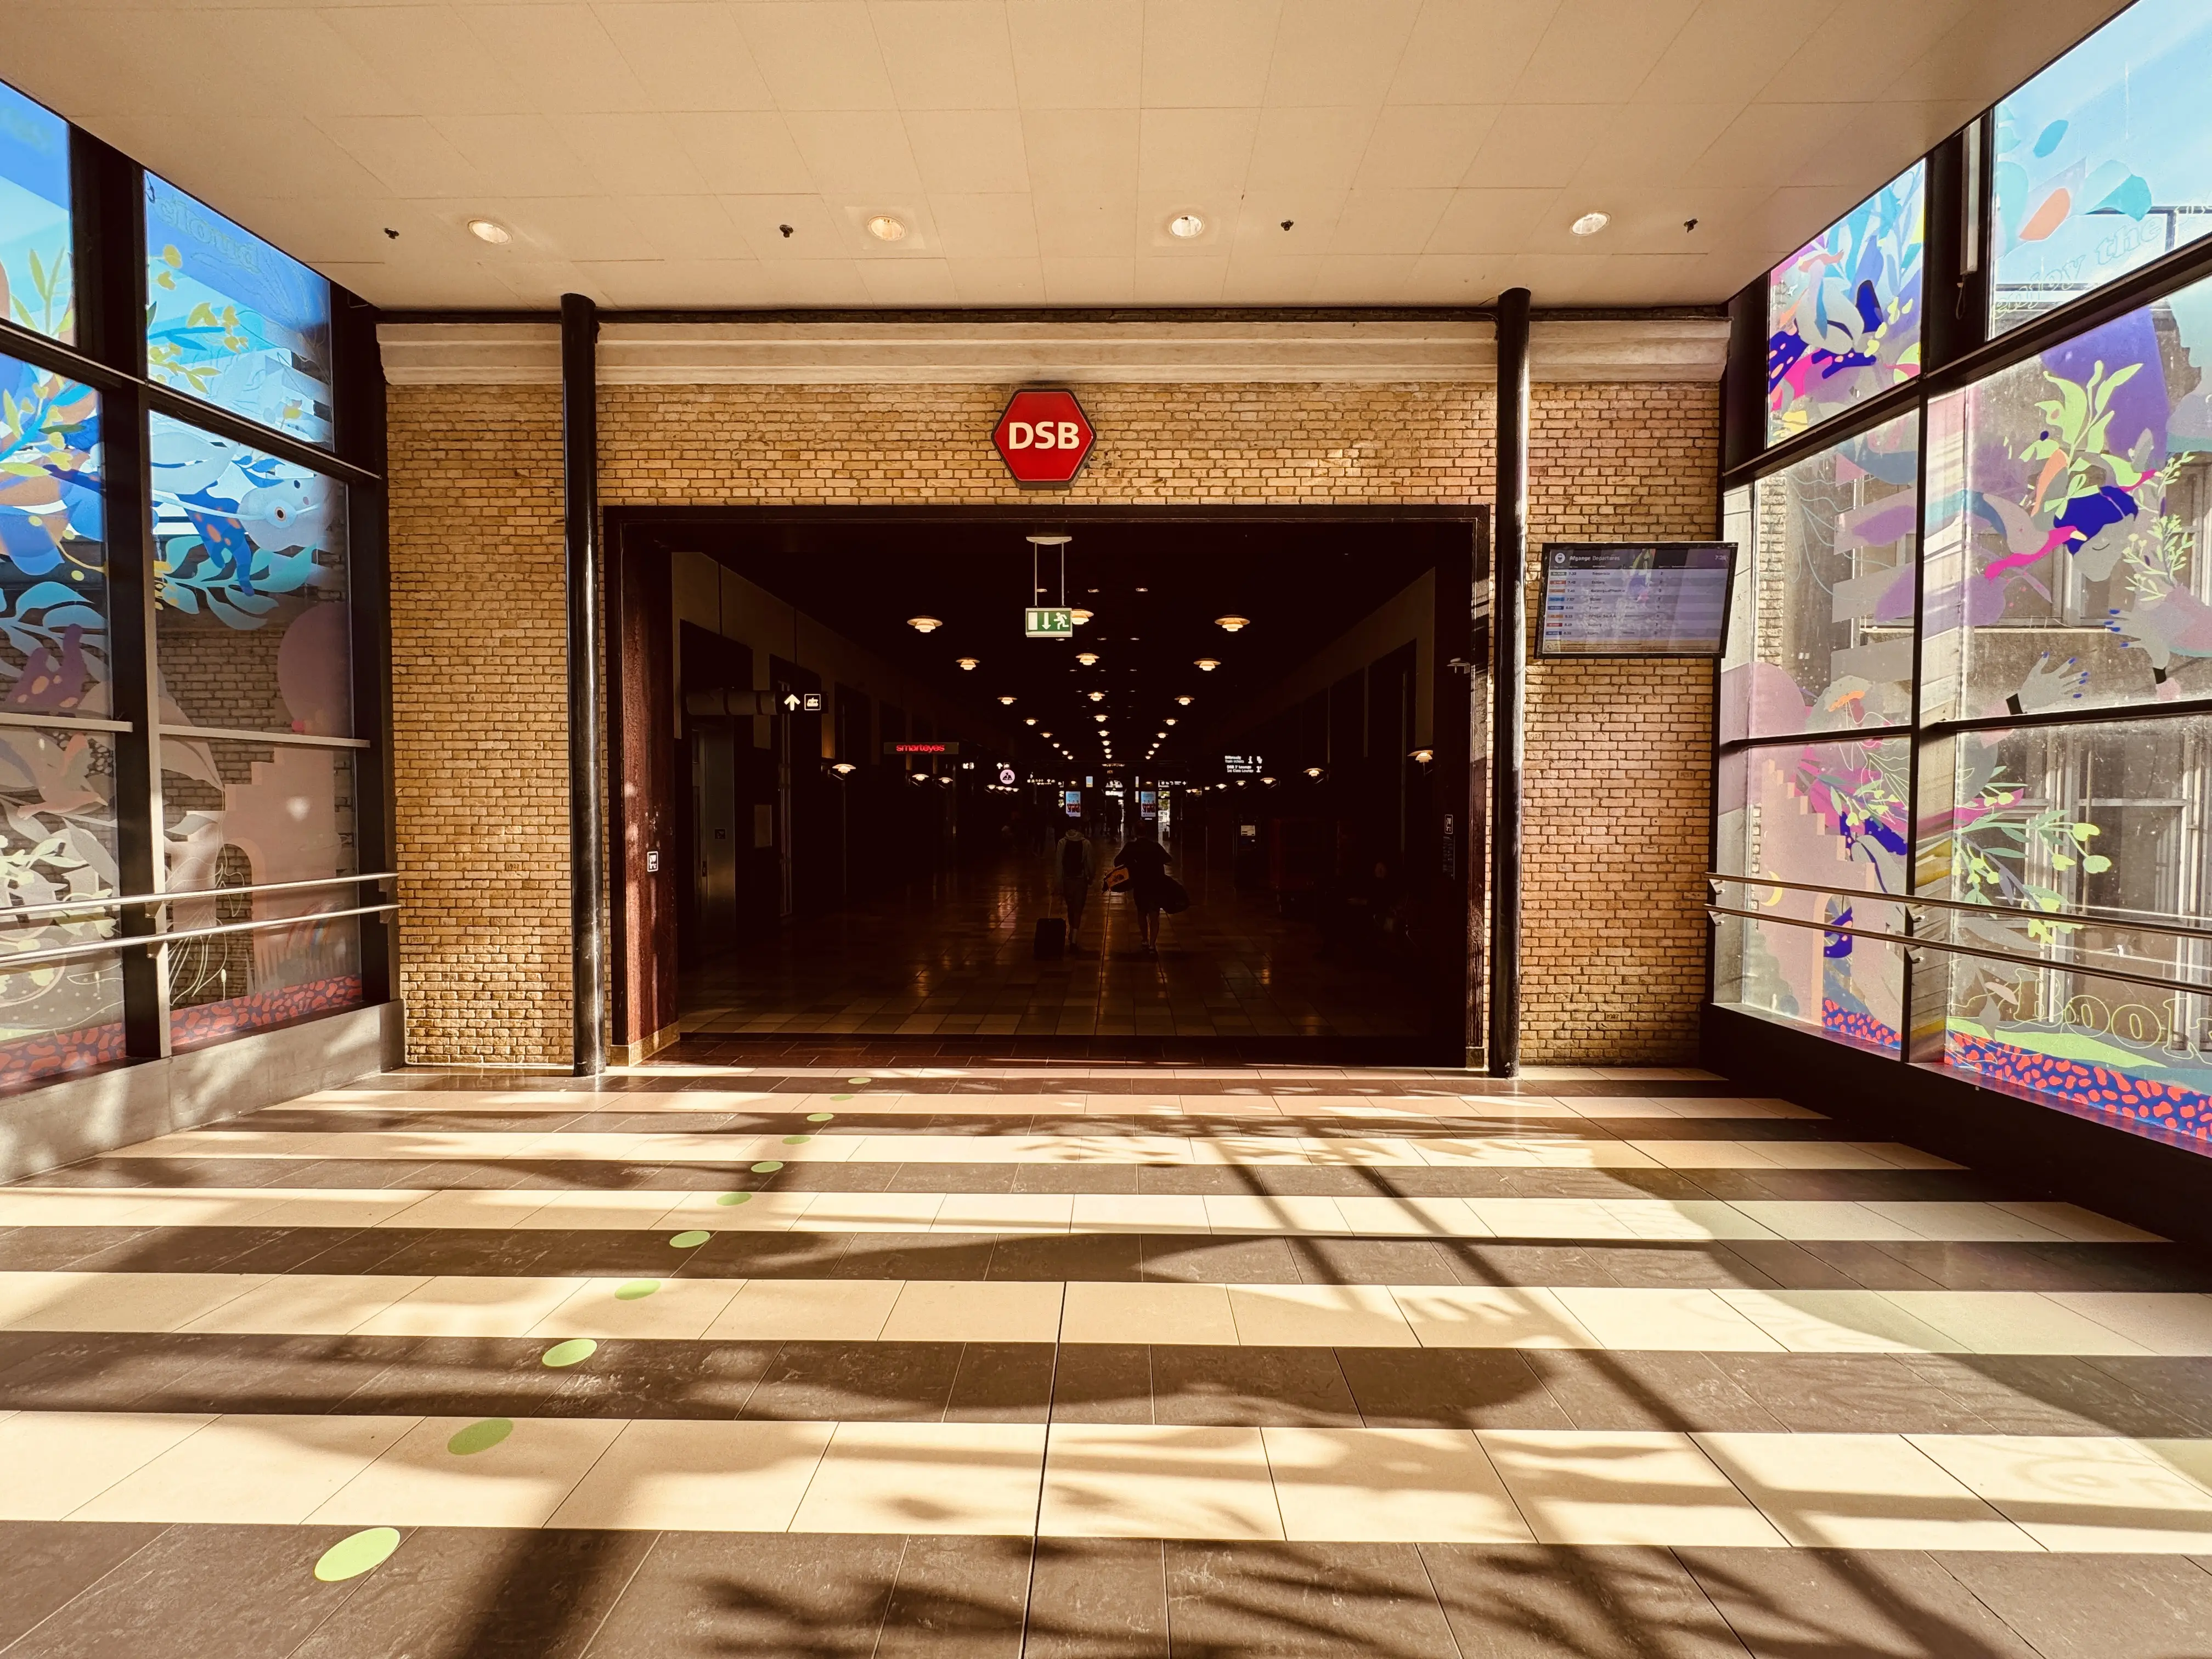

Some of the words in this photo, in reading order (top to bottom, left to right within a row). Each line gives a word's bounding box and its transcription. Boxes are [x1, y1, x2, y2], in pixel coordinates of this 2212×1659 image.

[2095, 216, 2163, 265] the
[1009, 421, 1080, 449] DSB
[896, 744, 945, 753] smarteyes
